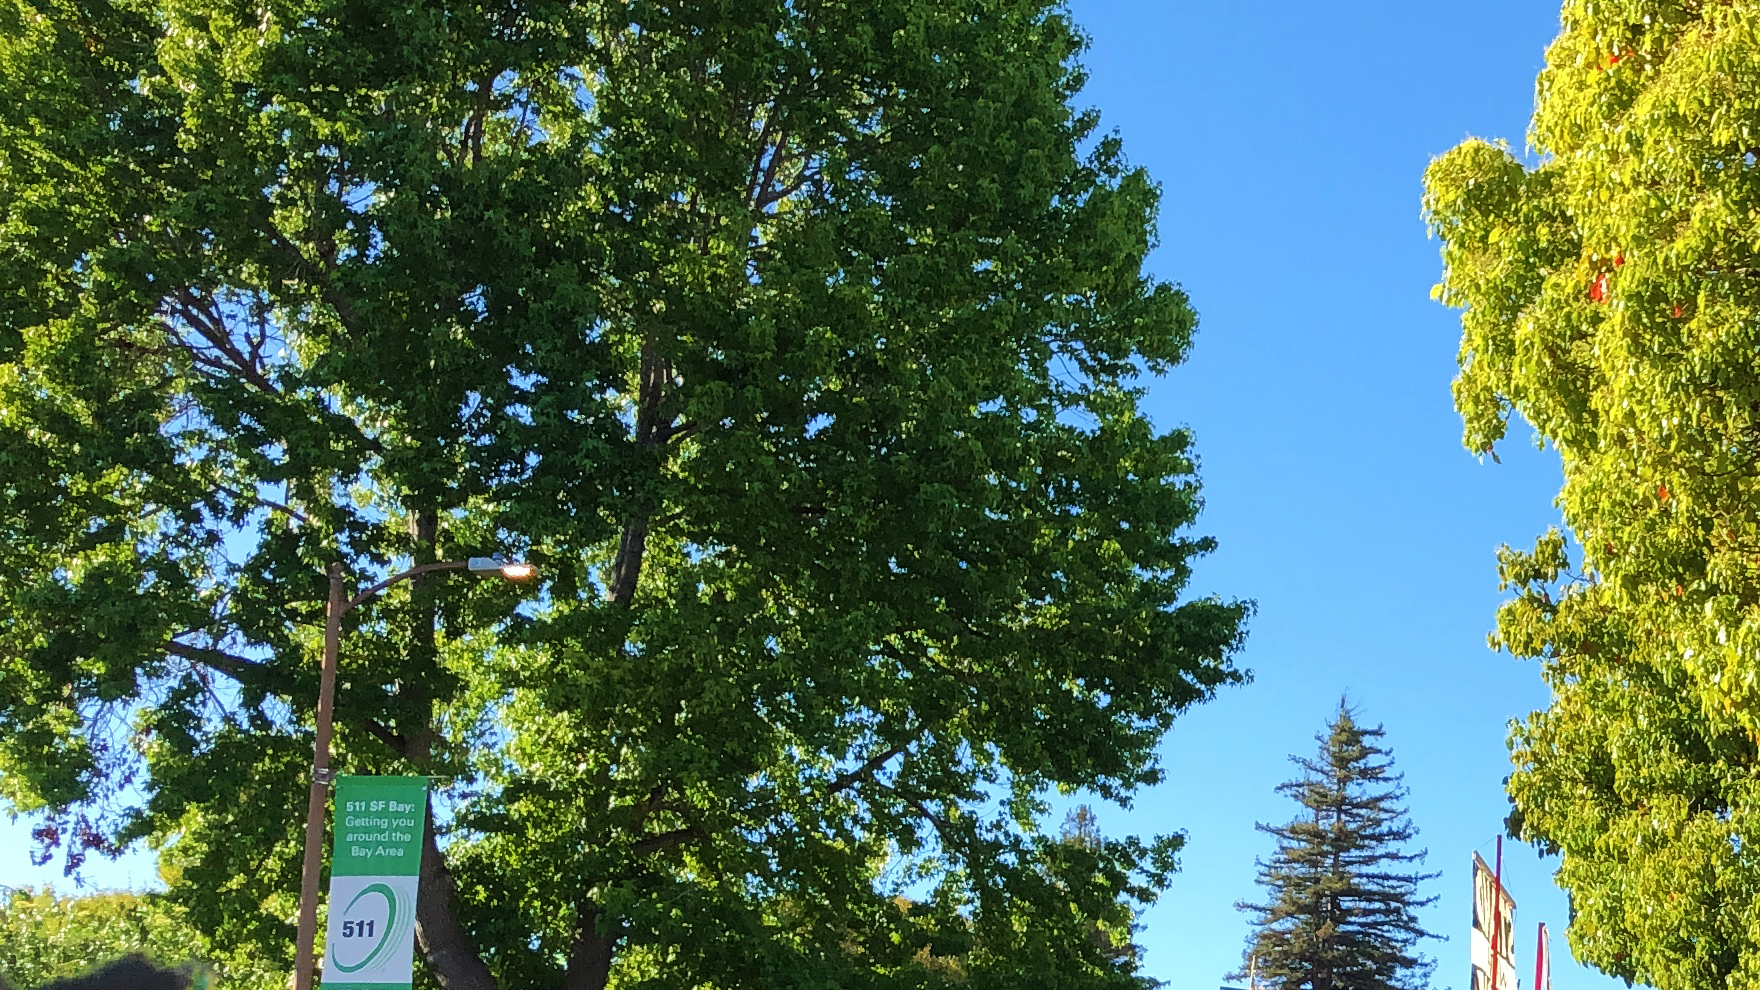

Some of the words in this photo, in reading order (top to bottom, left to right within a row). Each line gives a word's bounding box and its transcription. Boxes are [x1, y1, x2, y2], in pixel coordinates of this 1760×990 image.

[346, 801, 368, 812] 511
[370, 801, 386, 812] SF
[388, 801, 415, 814] Bay:
[345, 816, 388, 830] Getting
[391, 818, 415, 830] you
[346, 831, 388, 842] around
[391, 831, 412, 842] the
[351, 846, 372, 858] Bay
[374, 846, 404, 857] Area
[342, 920, 375, 938] 511
